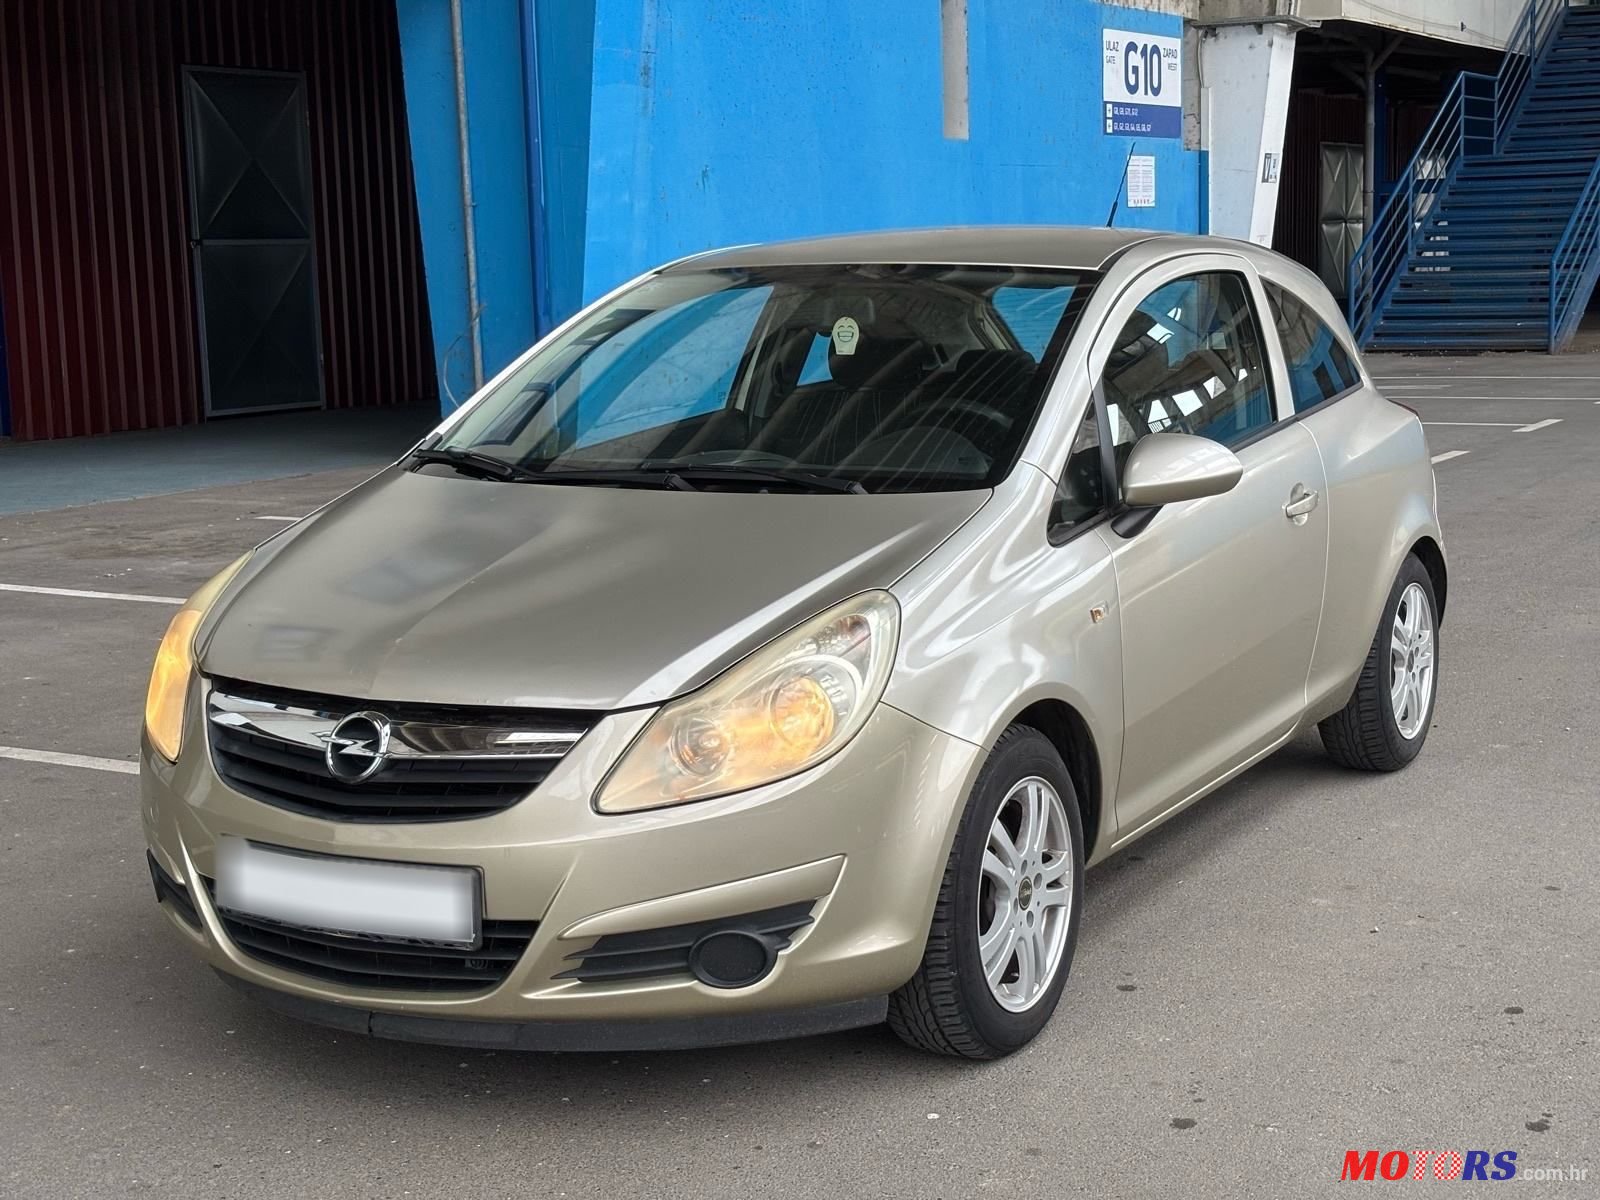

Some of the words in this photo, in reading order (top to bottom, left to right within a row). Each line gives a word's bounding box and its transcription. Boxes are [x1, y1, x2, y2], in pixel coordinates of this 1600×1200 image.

[1105, 40, 1119, 52] ULAZ
[1105, 55, 1116, 64] GATE
[1124, 41, 1162, 97] G10
